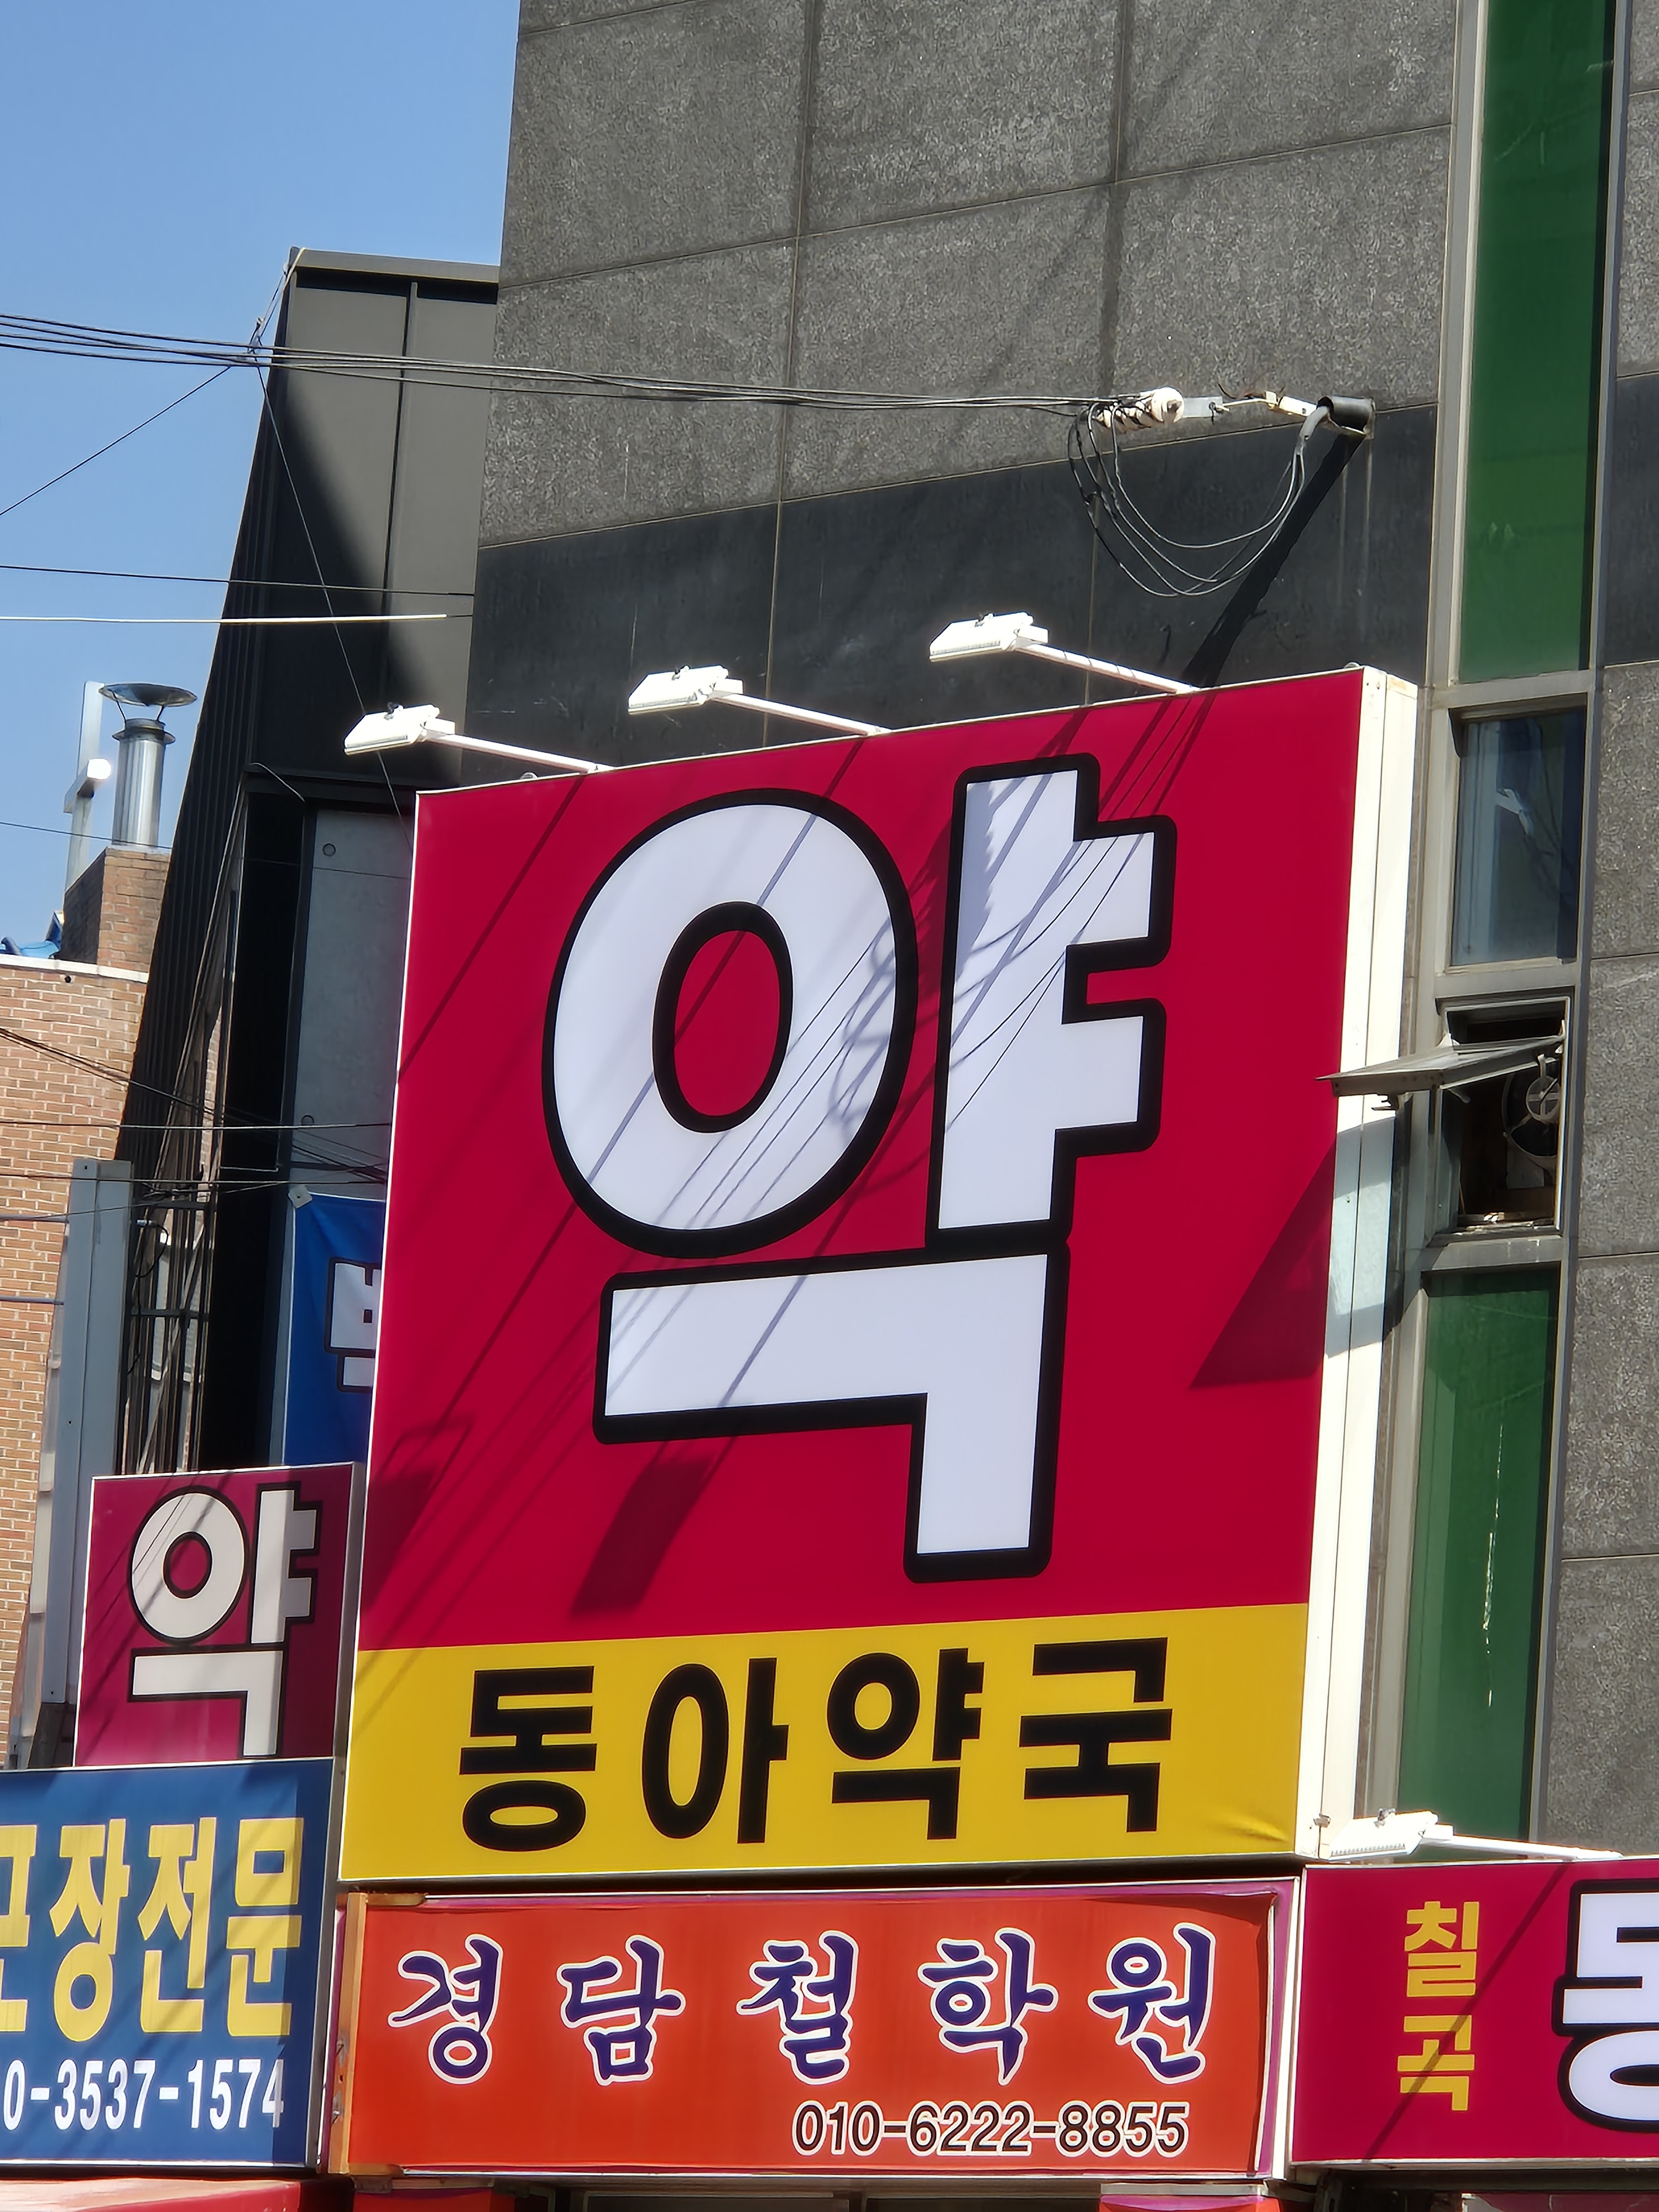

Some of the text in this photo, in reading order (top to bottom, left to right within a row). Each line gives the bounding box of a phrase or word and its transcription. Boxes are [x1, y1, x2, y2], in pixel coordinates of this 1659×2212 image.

[542, 753, 1177, 1583] 약
[127, 1481, 322, 1760] 약
[460, 1637, 1172, 1852] 동아약국
[1397, 1901, 1480, 2111] 칠곡
[792, 2100, 1190, 2157] 010-6222-8855
